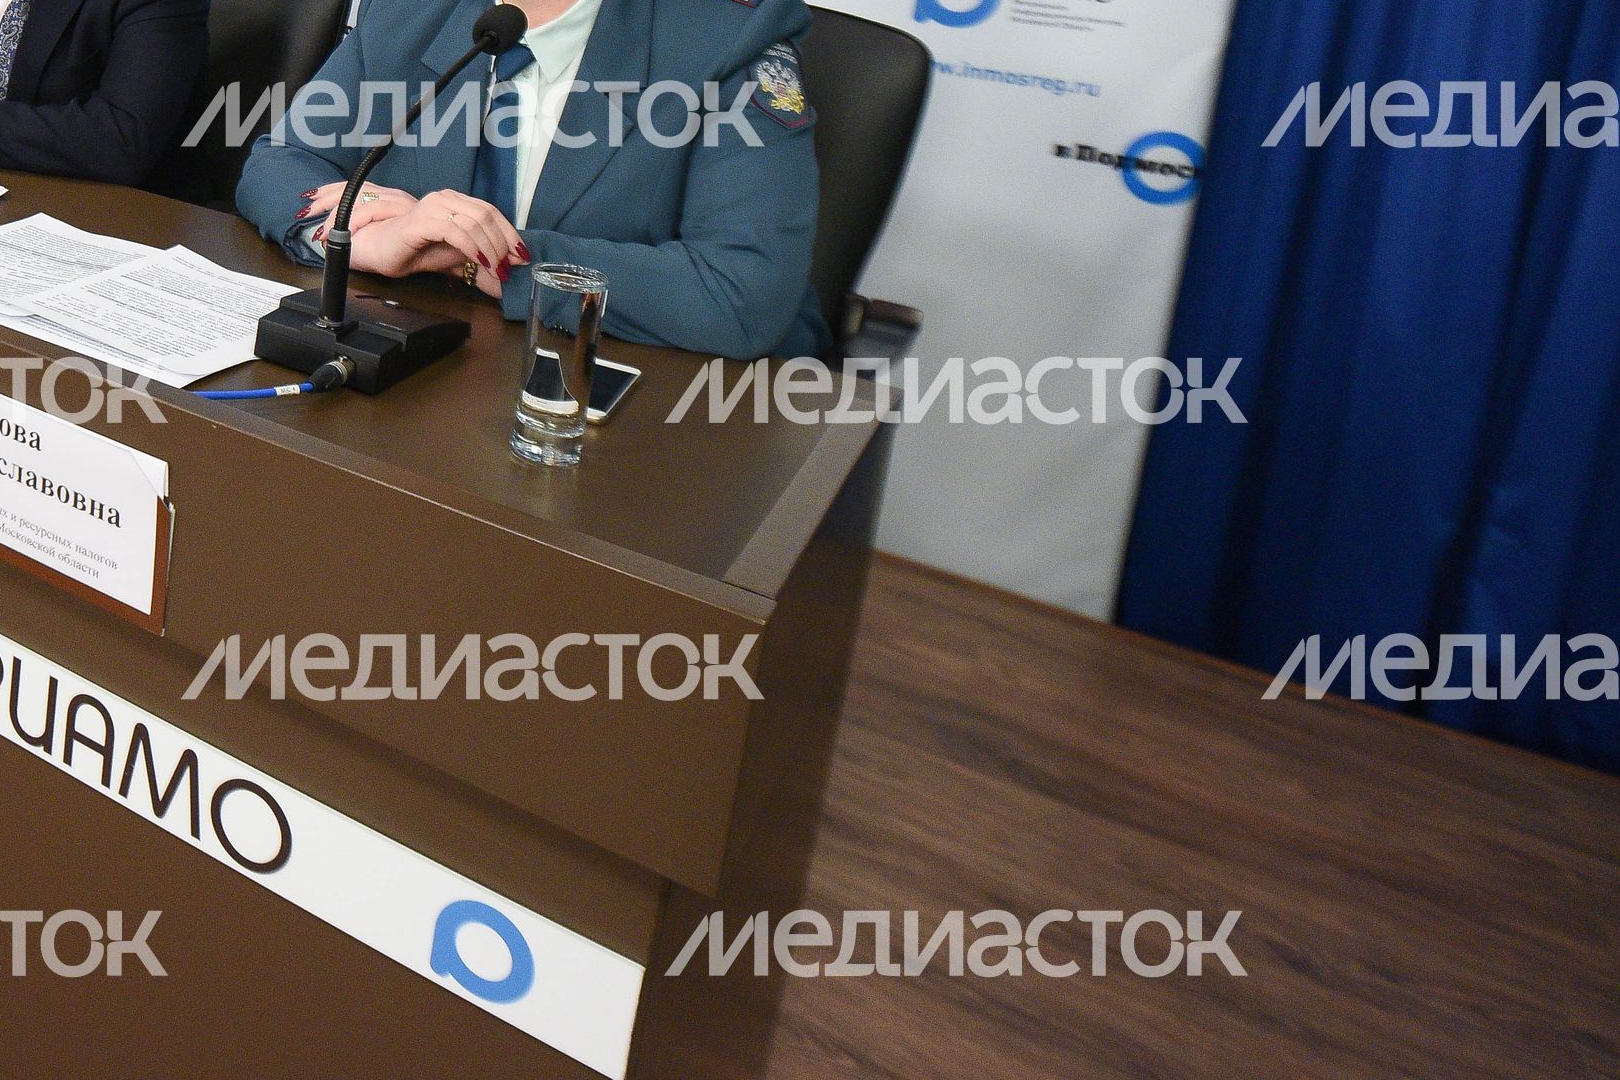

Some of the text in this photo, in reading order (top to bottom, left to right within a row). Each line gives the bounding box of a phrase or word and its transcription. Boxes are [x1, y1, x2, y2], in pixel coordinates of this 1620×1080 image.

[19, 515, 73, 550] ресурсных
[75, 545, 119, 571] налогов
[58, 551, 101, 580] области
